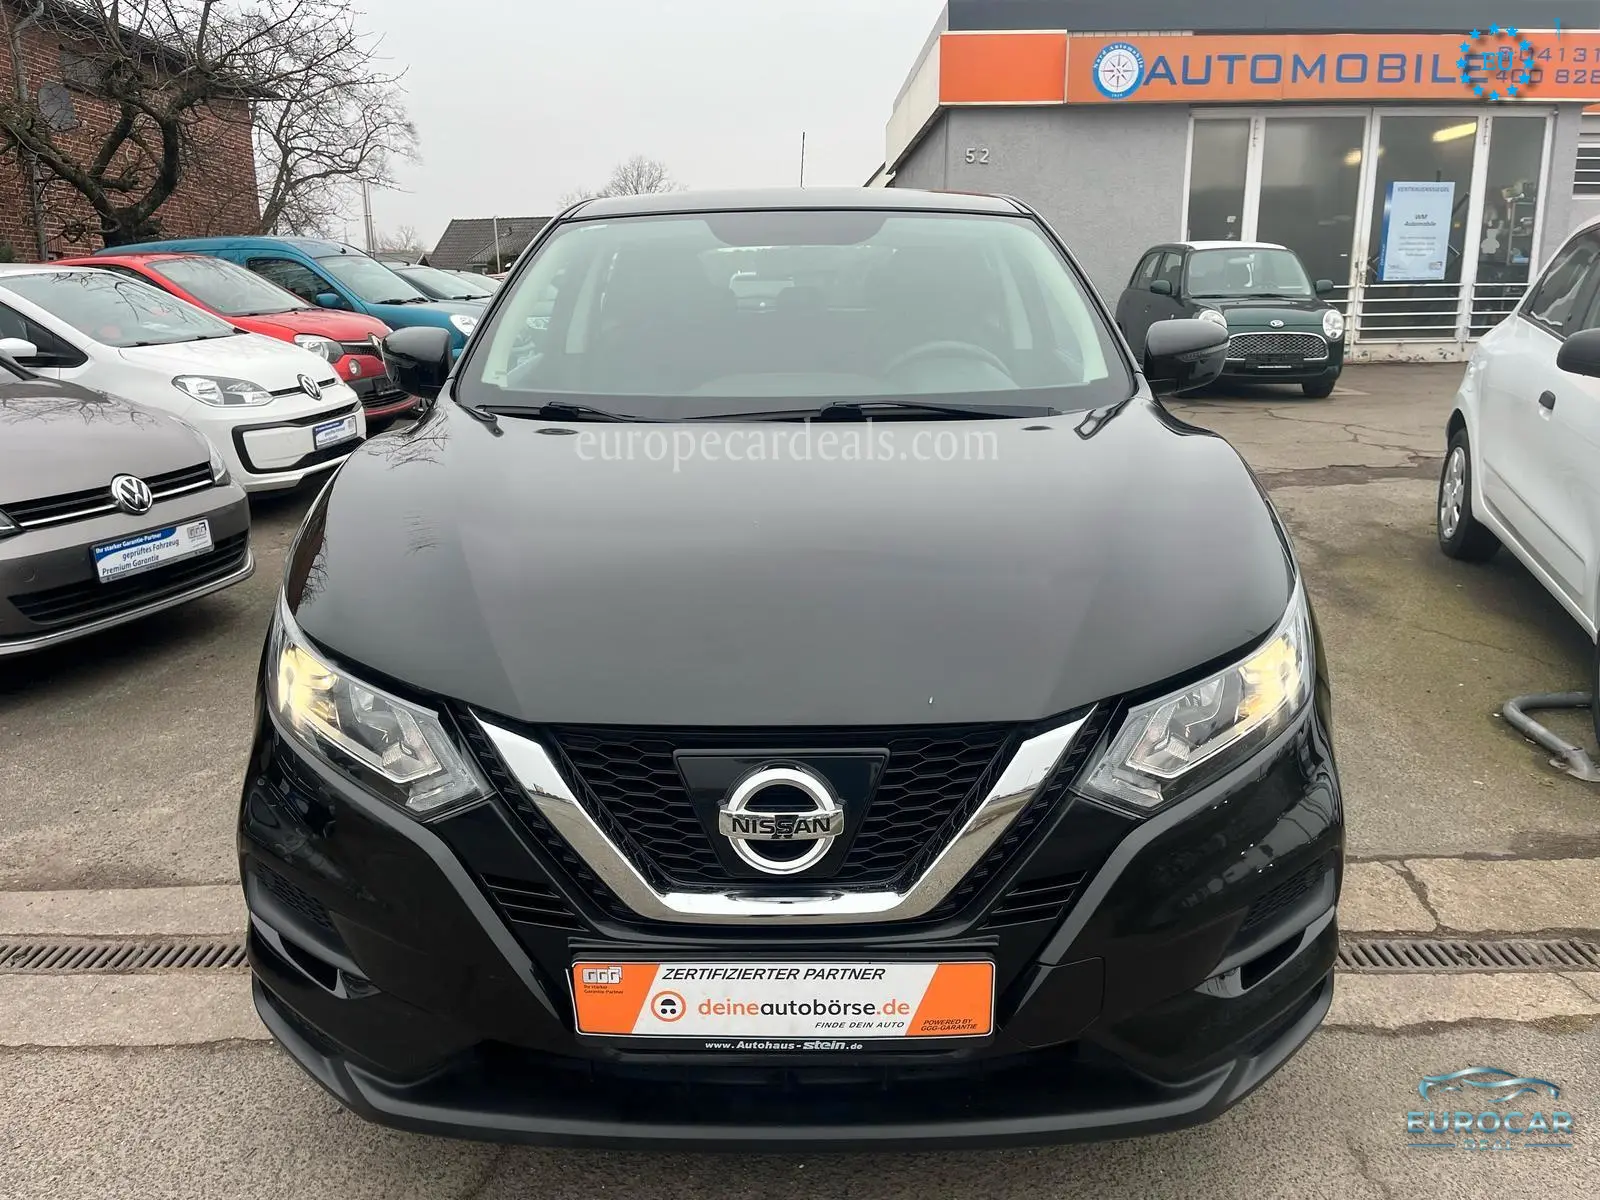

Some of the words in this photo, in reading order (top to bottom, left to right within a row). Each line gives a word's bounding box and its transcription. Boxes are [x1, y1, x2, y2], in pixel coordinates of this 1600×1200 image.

[1143, 53, 1489, 87] AUTOMOBILE
[965, 147, 989, 164] 52
[122, 545, 152, 561] geprüftes
[153, 539, 180, 550] Fahrzeug
[102, 561, 132, 576] Premium
[132, 554, 160, 567] Garantie
[731, 817, 831, 835] NISSAN
[662, 968, 801, 981] ZERTIFIZIERTER
[803, 968, 887, 980] PARTNER
[698, 999, 911, 1016] deineautobörse.de
[876, 1021, 905, 1029] AUTO
